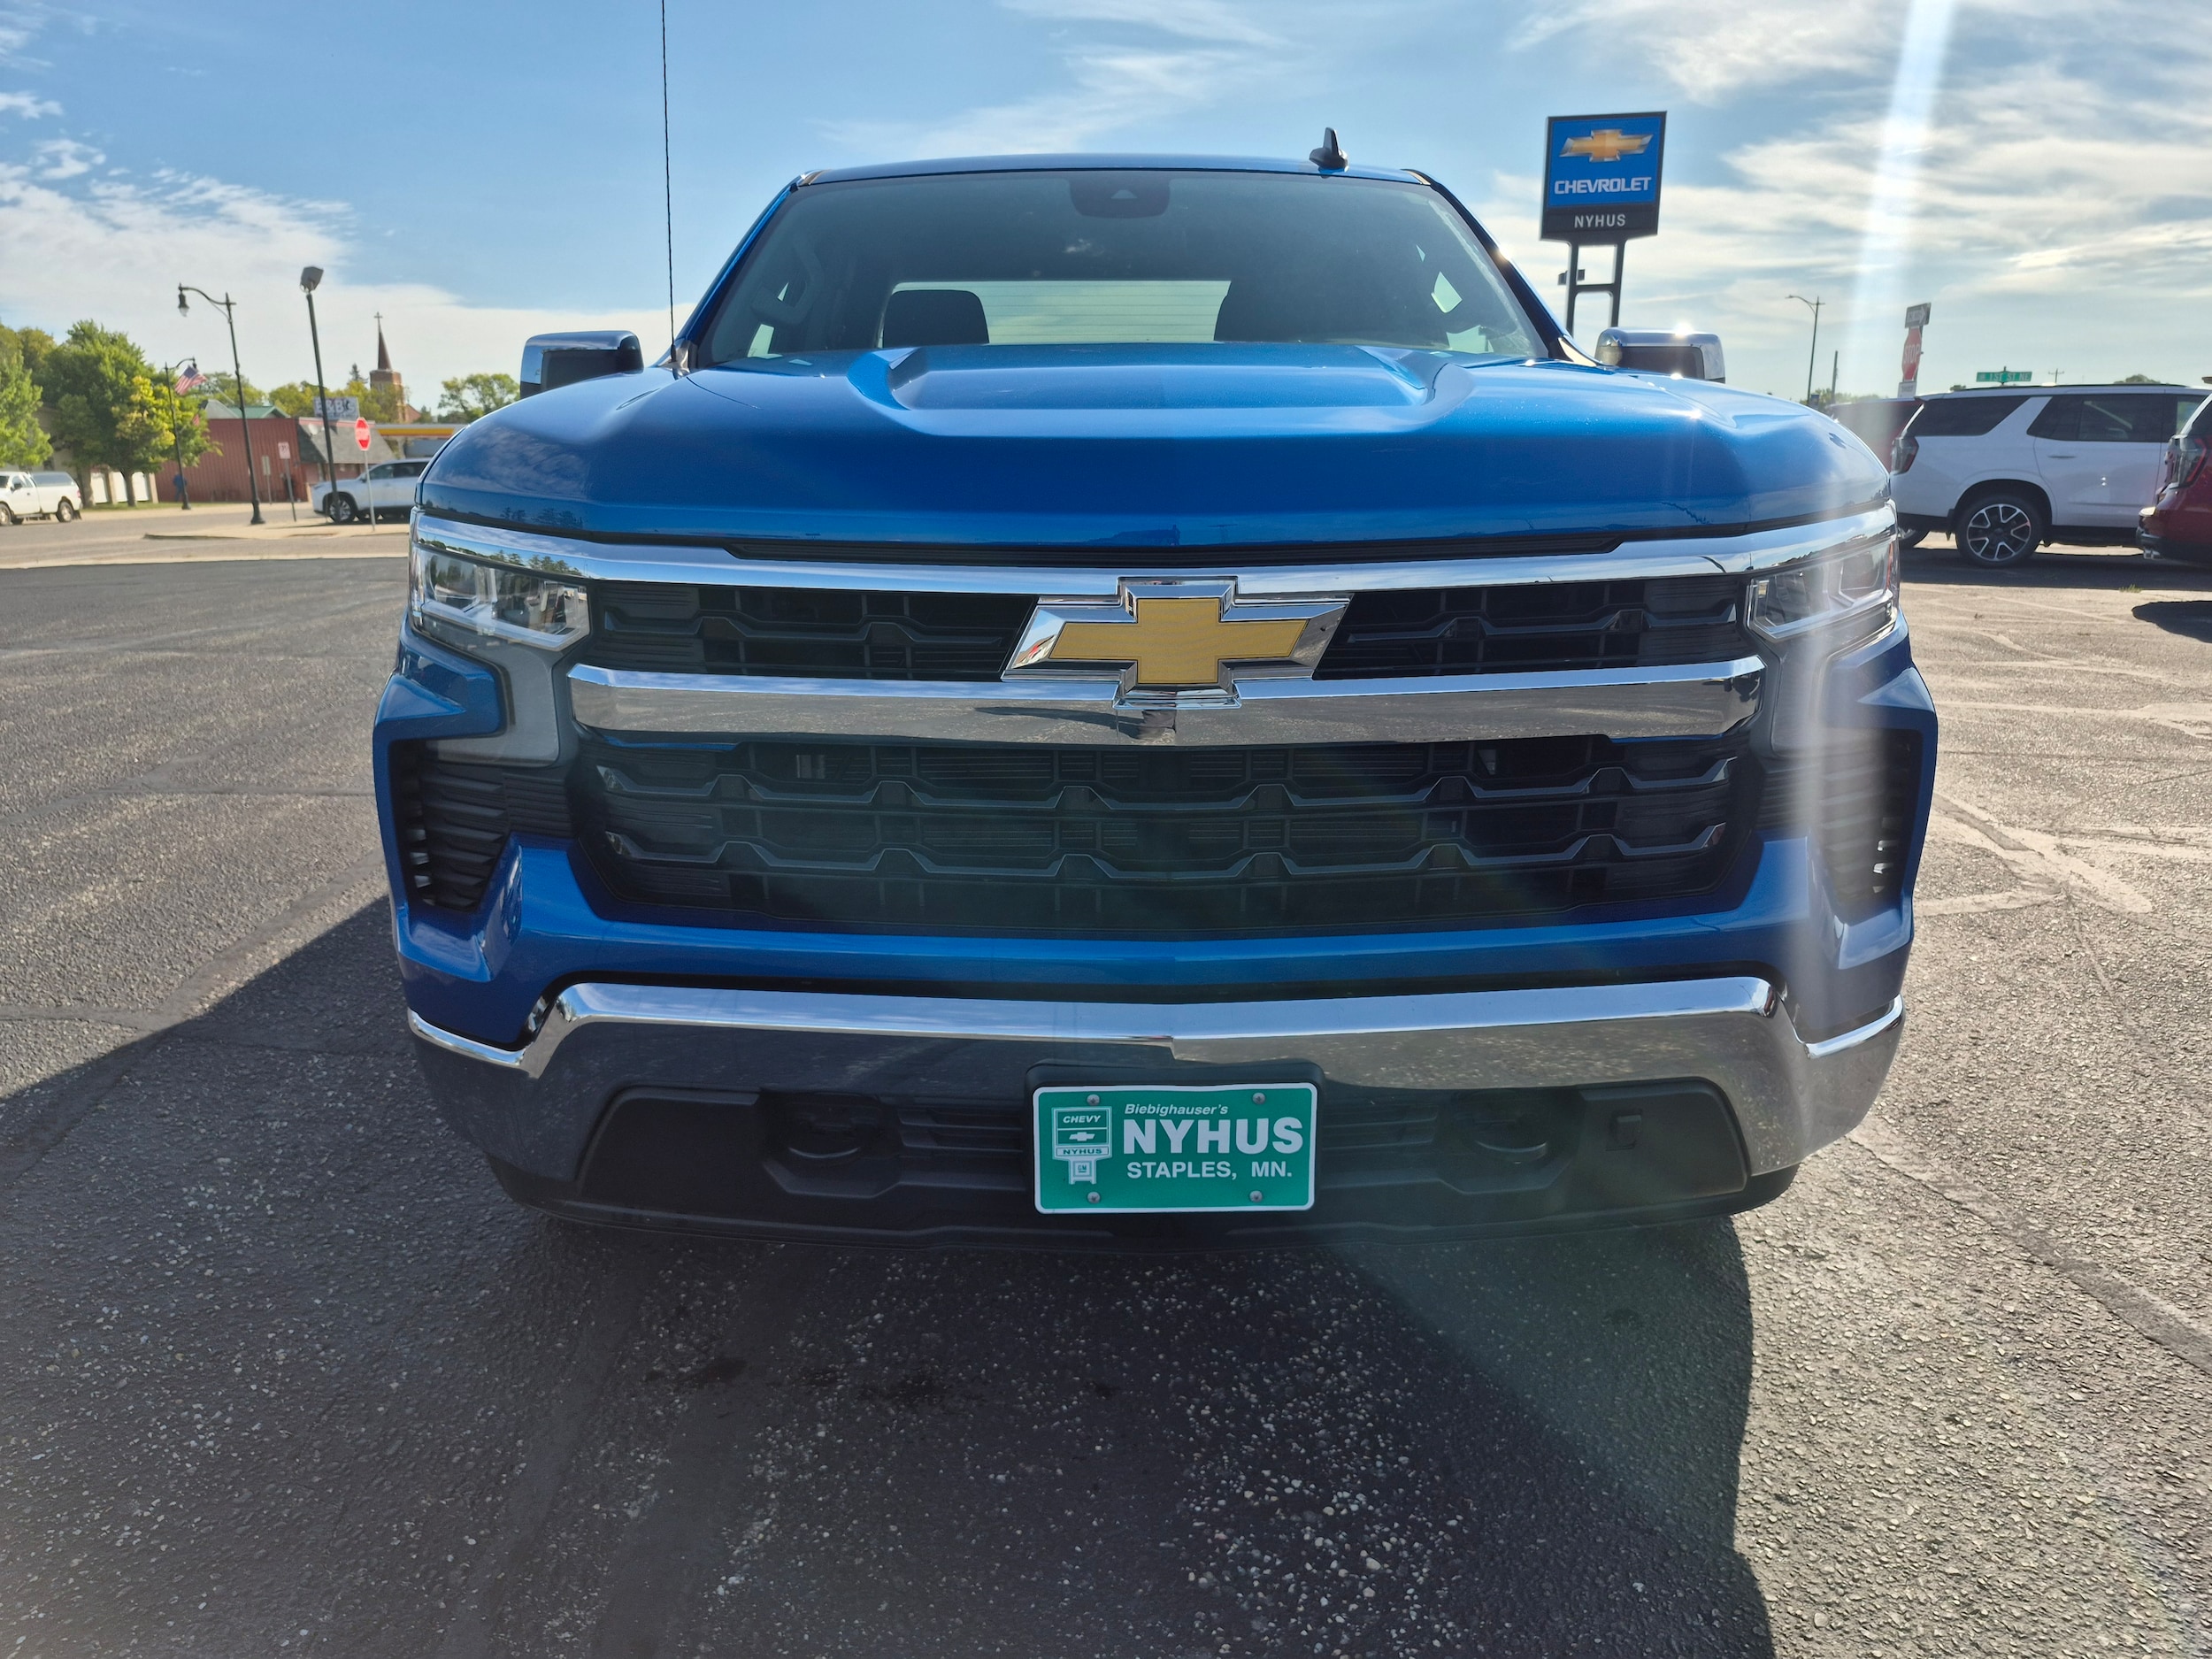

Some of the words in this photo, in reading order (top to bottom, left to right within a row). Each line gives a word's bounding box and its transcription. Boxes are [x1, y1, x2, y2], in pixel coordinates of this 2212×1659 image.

[1554, 177, 1652, 195] CHEVROLET
[1574, 213, 1626, 228] NYHUS
[1903, 343, 1921, 364] STOP
[1125, 1103, 1228, 1117] Biebighauser's
[1063, 1115, 1102, 1124] CHEVY
[1123, 1117, 1303, 1155] NYHUS
[1126, 1161, 1237, 1180] STAPLES,
[1251, 1161, 1293, 1178] MN.
